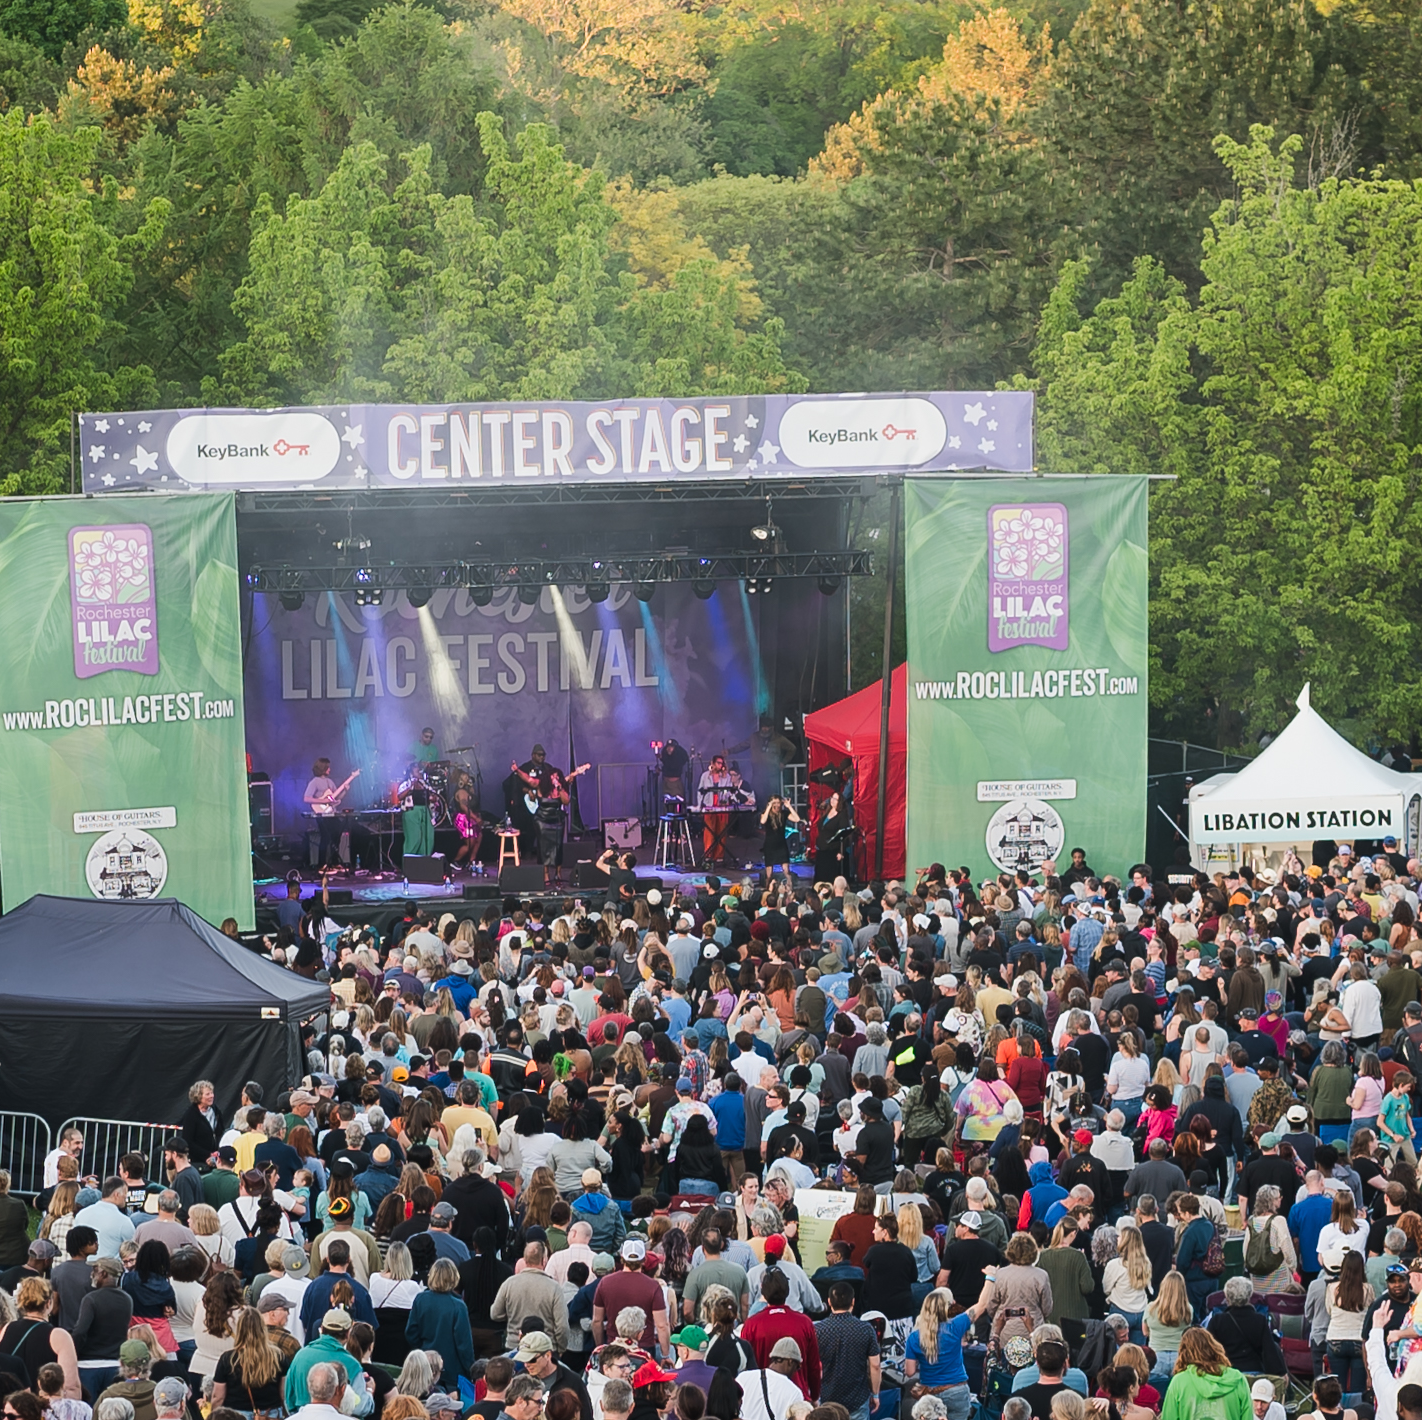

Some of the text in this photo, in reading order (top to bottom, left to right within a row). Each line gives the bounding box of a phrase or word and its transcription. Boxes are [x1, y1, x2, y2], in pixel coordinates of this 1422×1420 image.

[387, 404, 733, 480] CENTER STAGE
[808, 427, 878, 445] KeyBank
[197, 442, 270, 461] KeyBank
[994, 582, 1063, 596] Rochester
[76, 604, 151, 619] Rochester
[993, 597, 1064, 619] LILAC
[78, 618, 152, 642] LILAC
[998, 615, 1057, 640] festival
[83, 640, 147, 664] festival
[282, 628, 660, 700] LILAC FESTIVAL
[1203, 806, 1393, 832] LIBATION STATION
